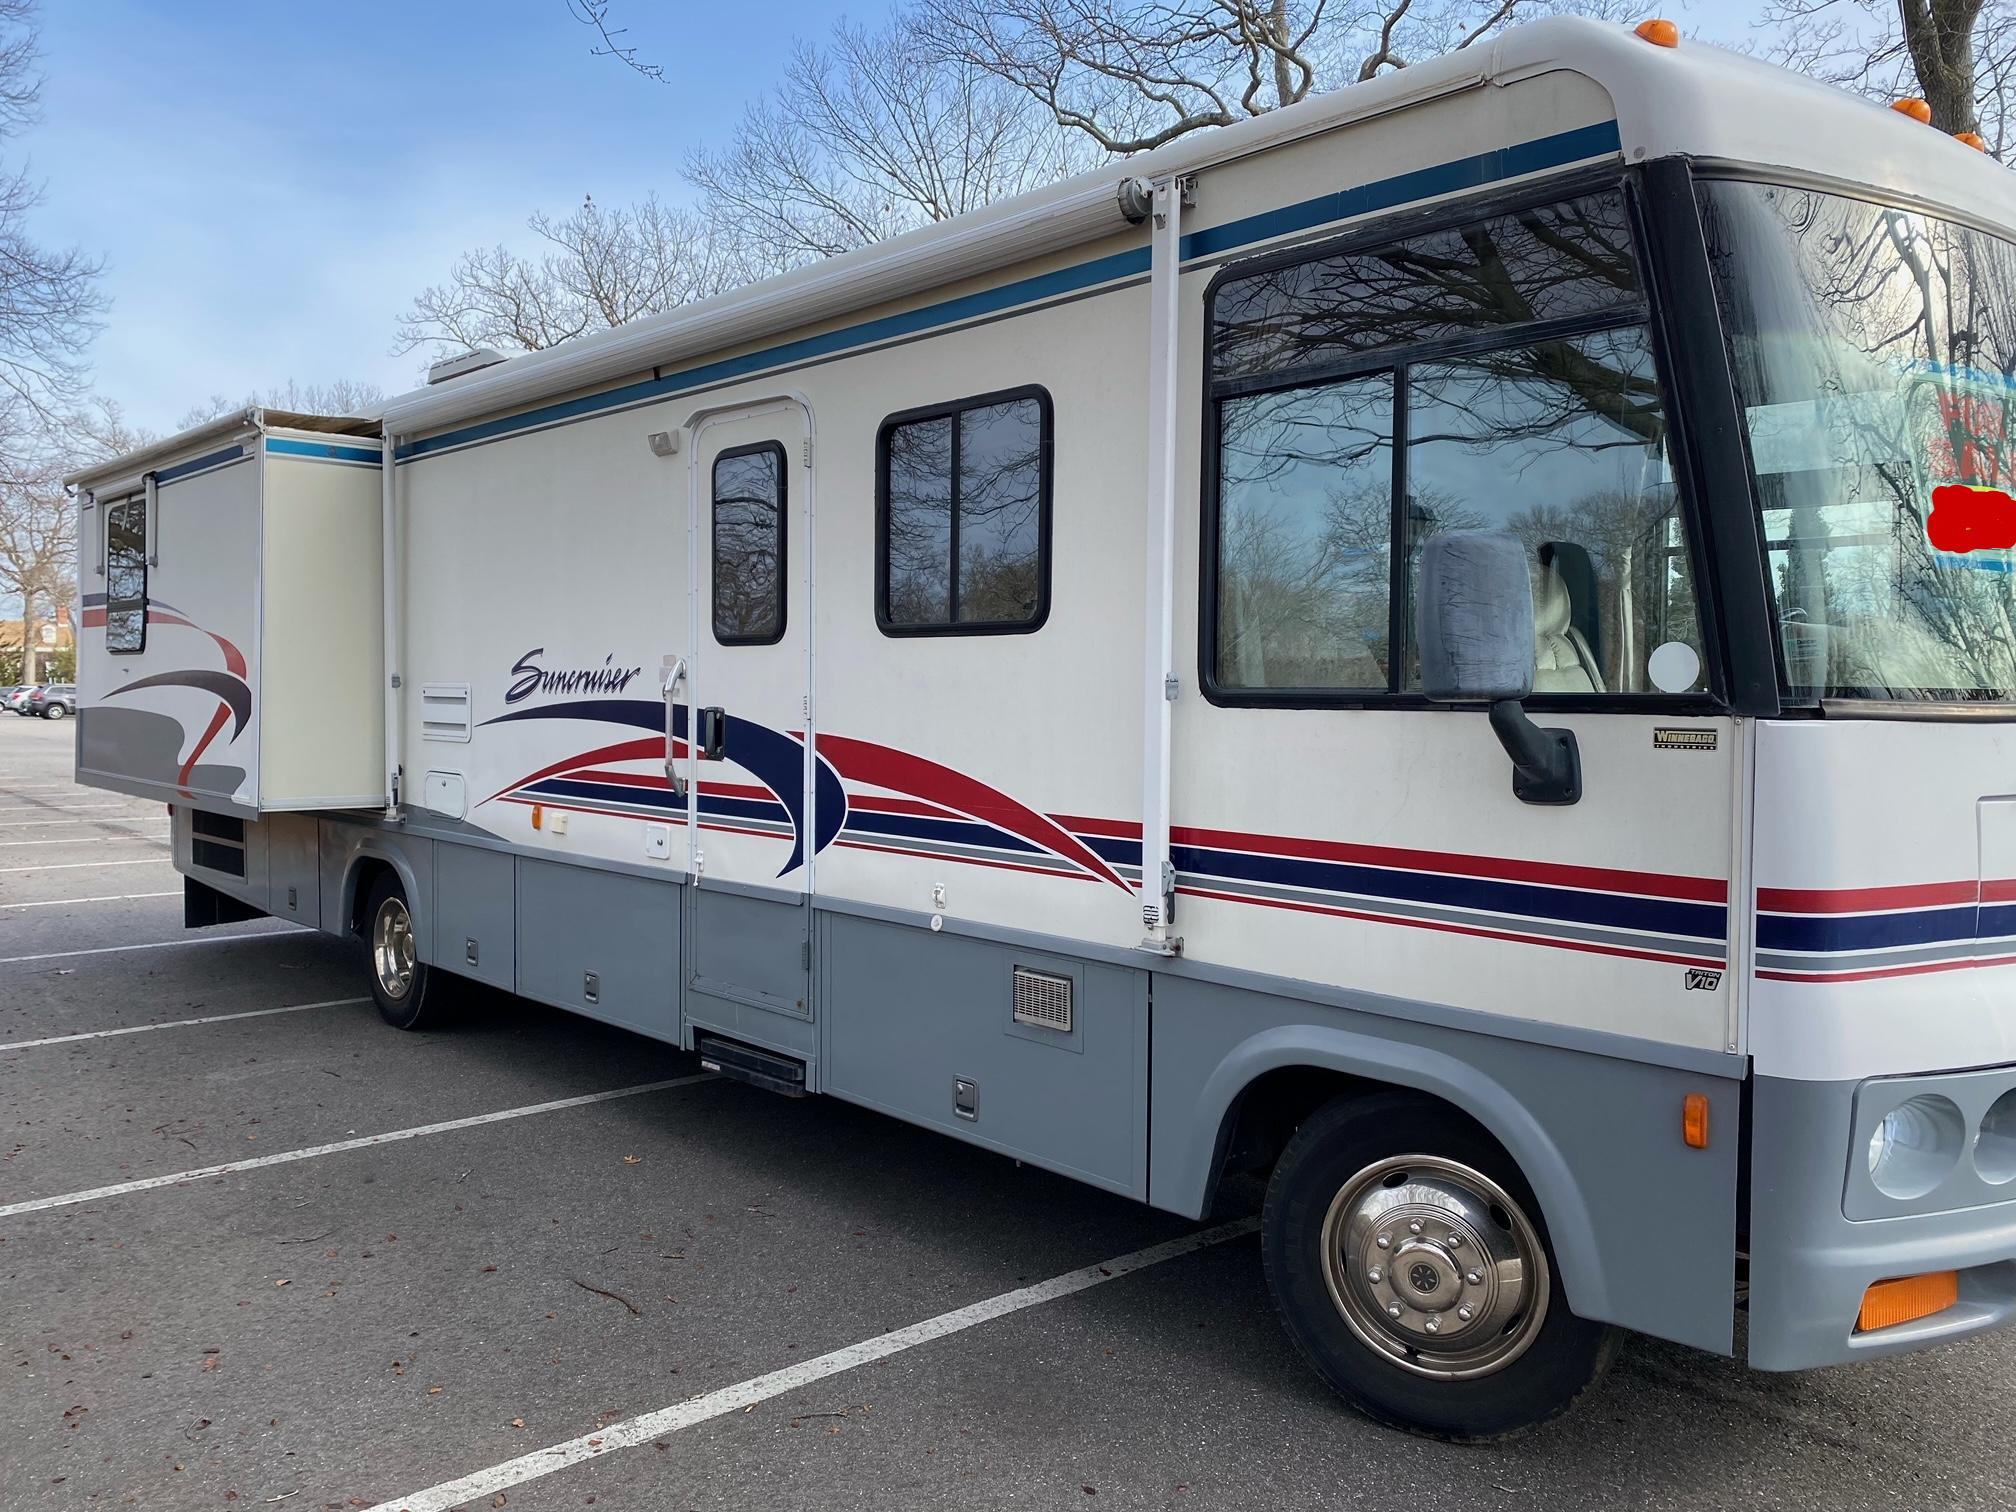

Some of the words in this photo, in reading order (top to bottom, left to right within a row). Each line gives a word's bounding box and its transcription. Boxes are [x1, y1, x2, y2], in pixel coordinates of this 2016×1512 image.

[505, 648, 641, 704] Suncruiser
[1657, 731, 1715, 743] WINNEBAGO
[1690, 970, 1720, 978] TRITON
[1686, 974, 1718, 989] V10
